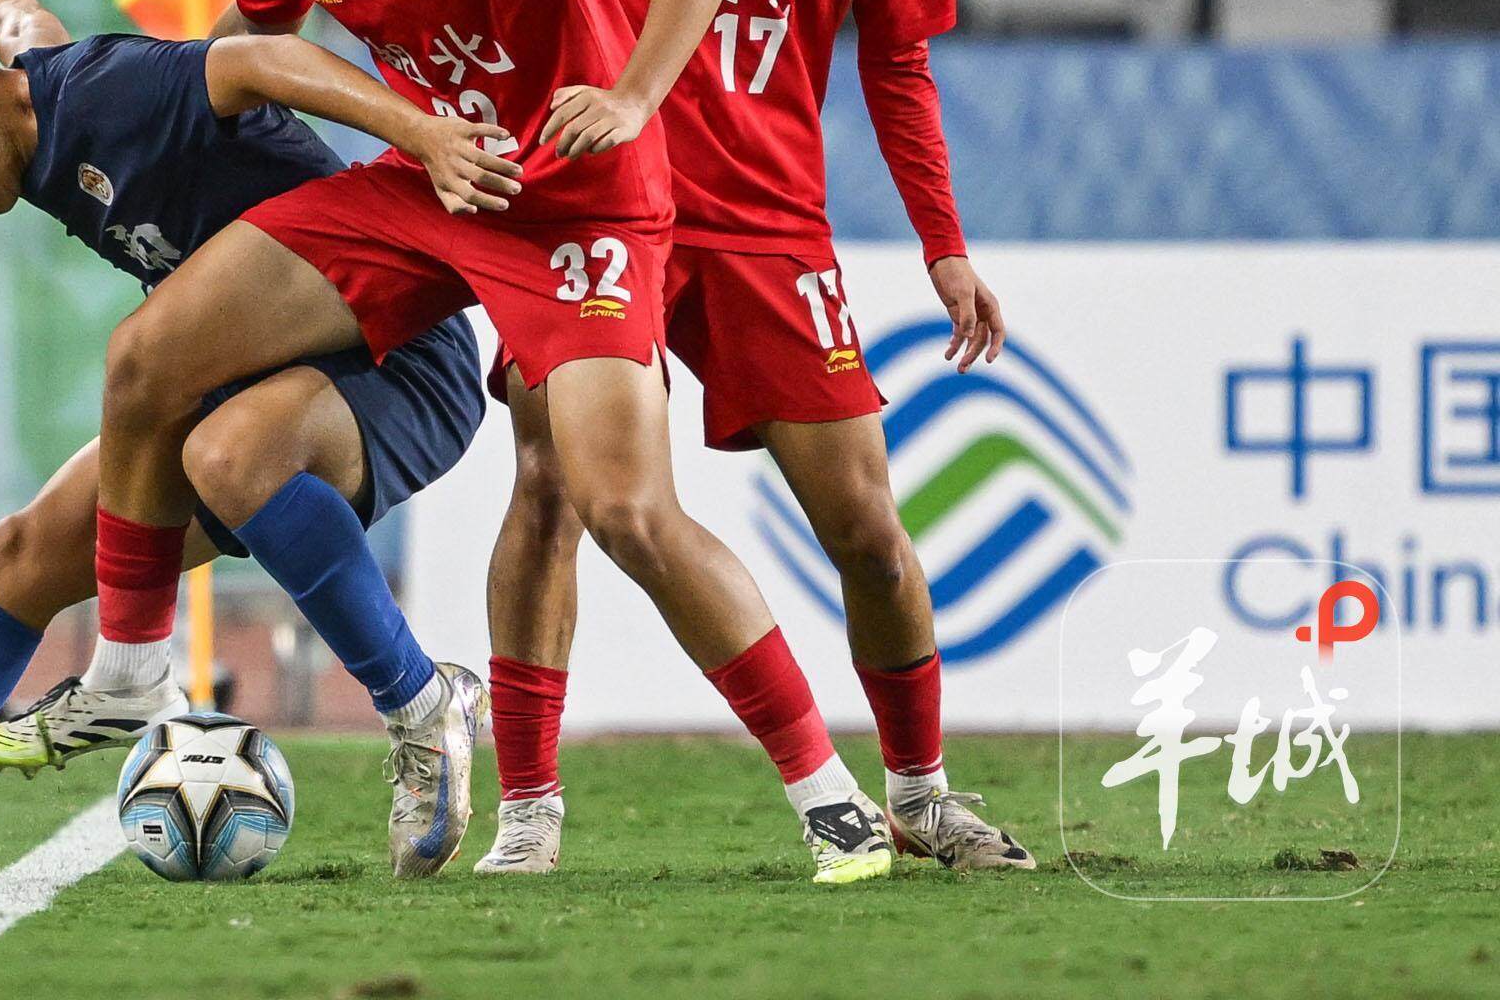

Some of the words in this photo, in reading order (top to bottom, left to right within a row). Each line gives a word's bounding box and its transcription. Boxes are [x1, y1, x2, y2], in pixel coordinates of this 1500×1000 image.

[713, 13, 788, 95] 17
[549, 236, 631, 303] 32
[579, 308, 626, 319] LI-NING
[1220, 333, 1500, 500] 中国
[1221, 526, 1500, 634] Chin
